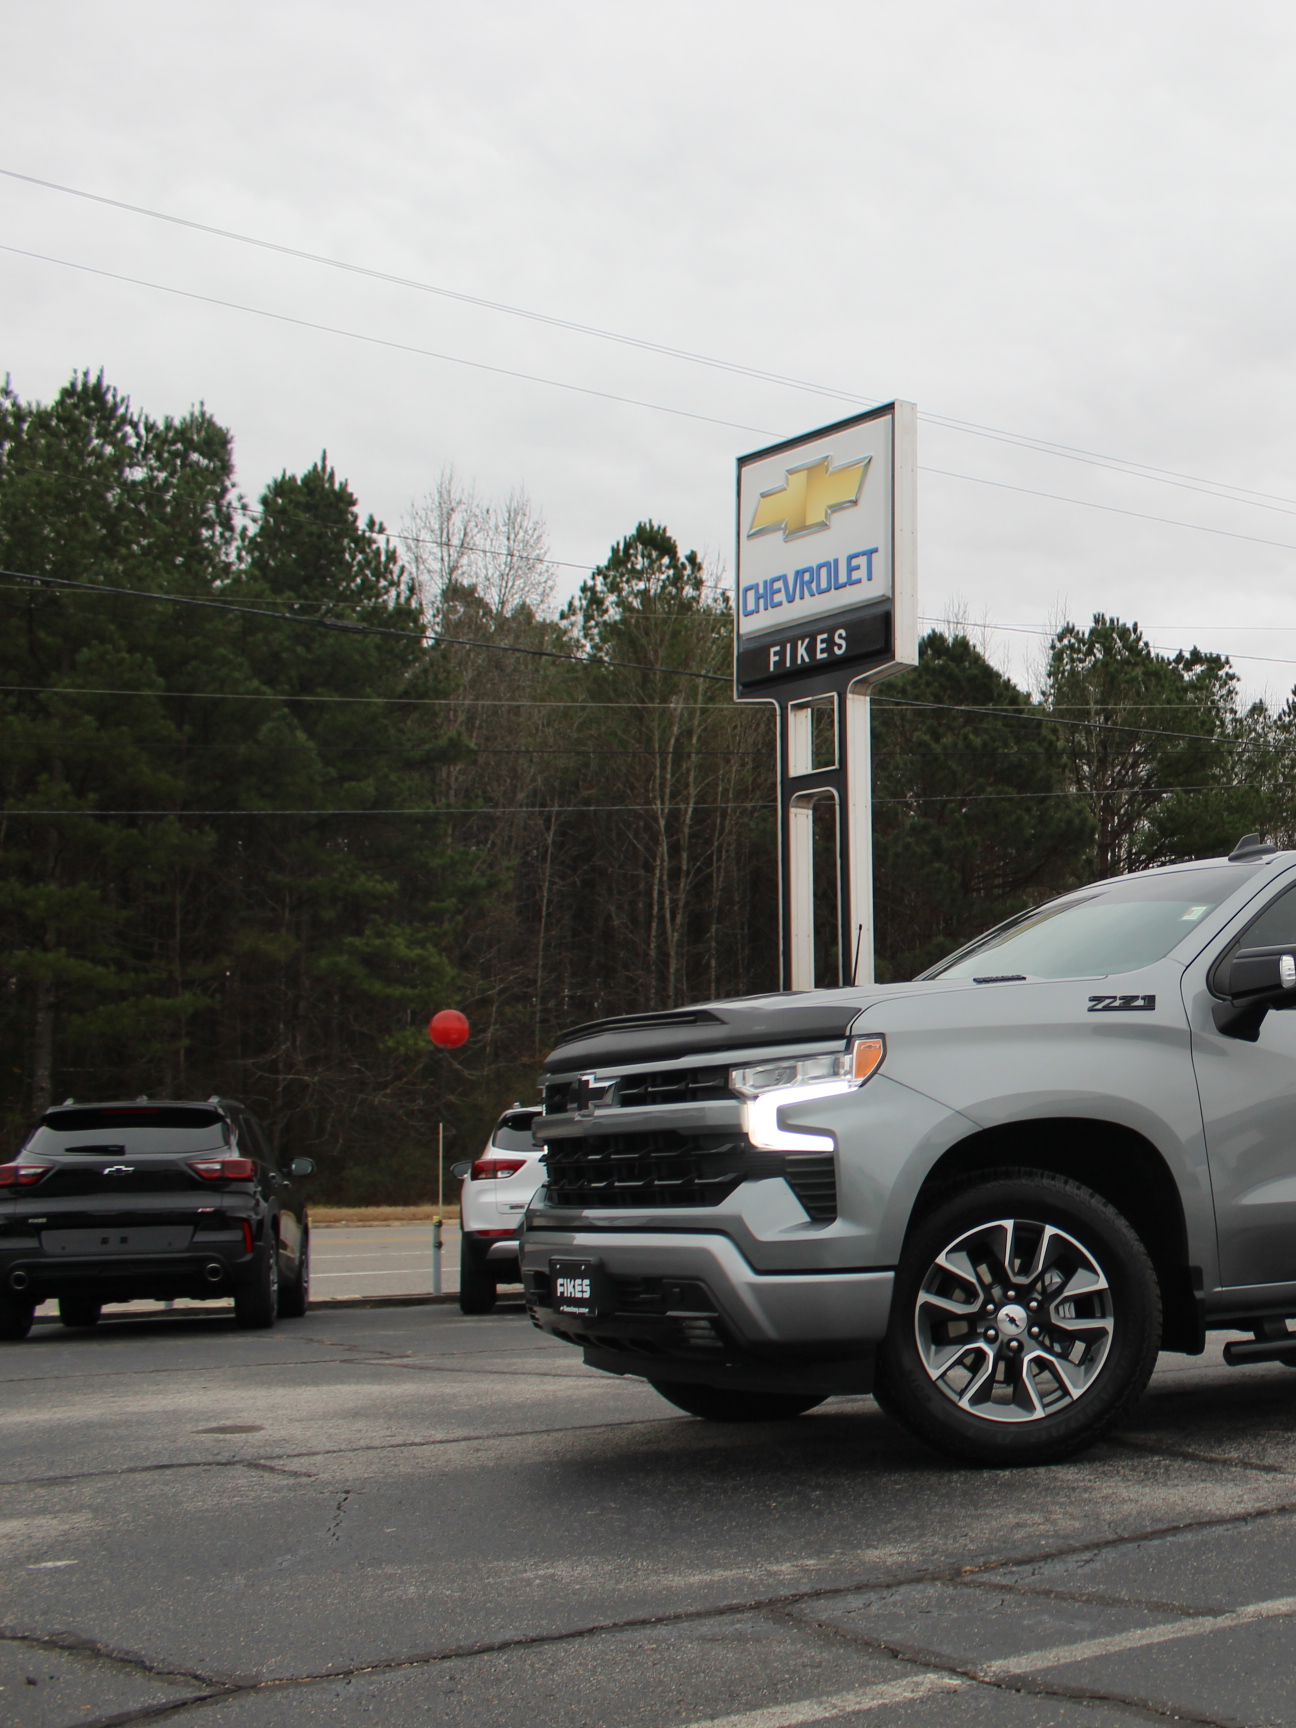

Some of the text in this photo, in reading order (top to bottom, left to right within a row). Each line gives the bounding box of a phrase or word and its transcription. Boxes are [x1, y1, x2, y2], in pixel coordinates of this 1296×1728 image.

[742, 547, 878, 617] CHEVROLET
[769, 628, 847, 672] FIKES
[1087, 994, 1156, 1012] Z71
[556, 1277, 591, 1298] FIKES
